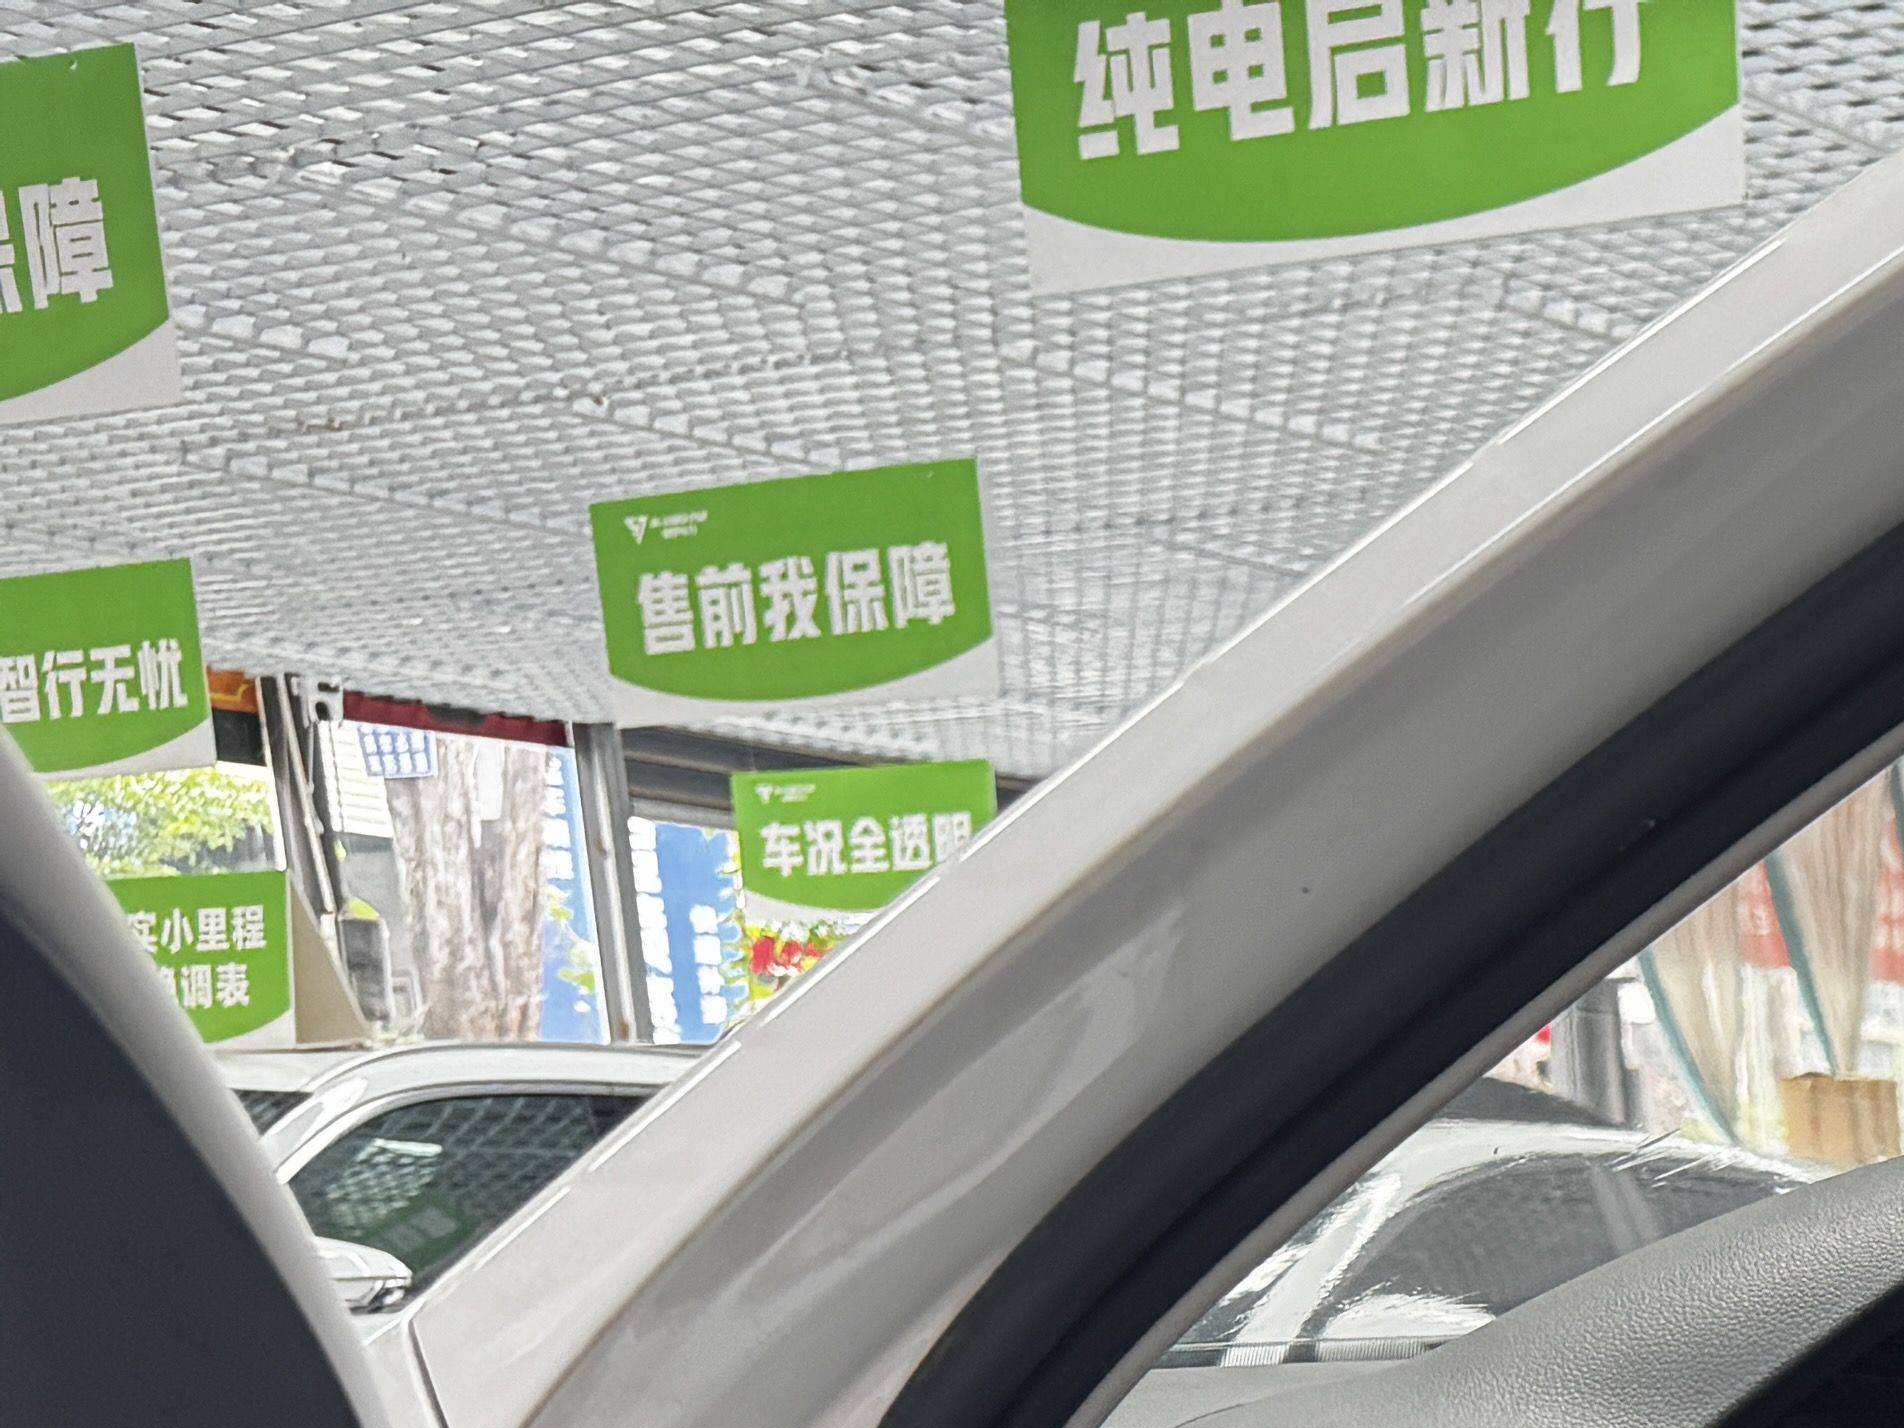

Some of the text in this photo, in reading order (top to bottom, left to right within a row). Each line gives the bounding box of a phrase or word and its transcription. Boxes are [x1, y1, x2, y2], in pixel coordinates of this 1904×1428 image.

[1073, 0, 1642, 161] 纯电启新行
[638, 540, 956, 656] 售前我保障
[0, 637, 189, 724] 智行无忧
[759, 811, 973, 877] 车况全透明
